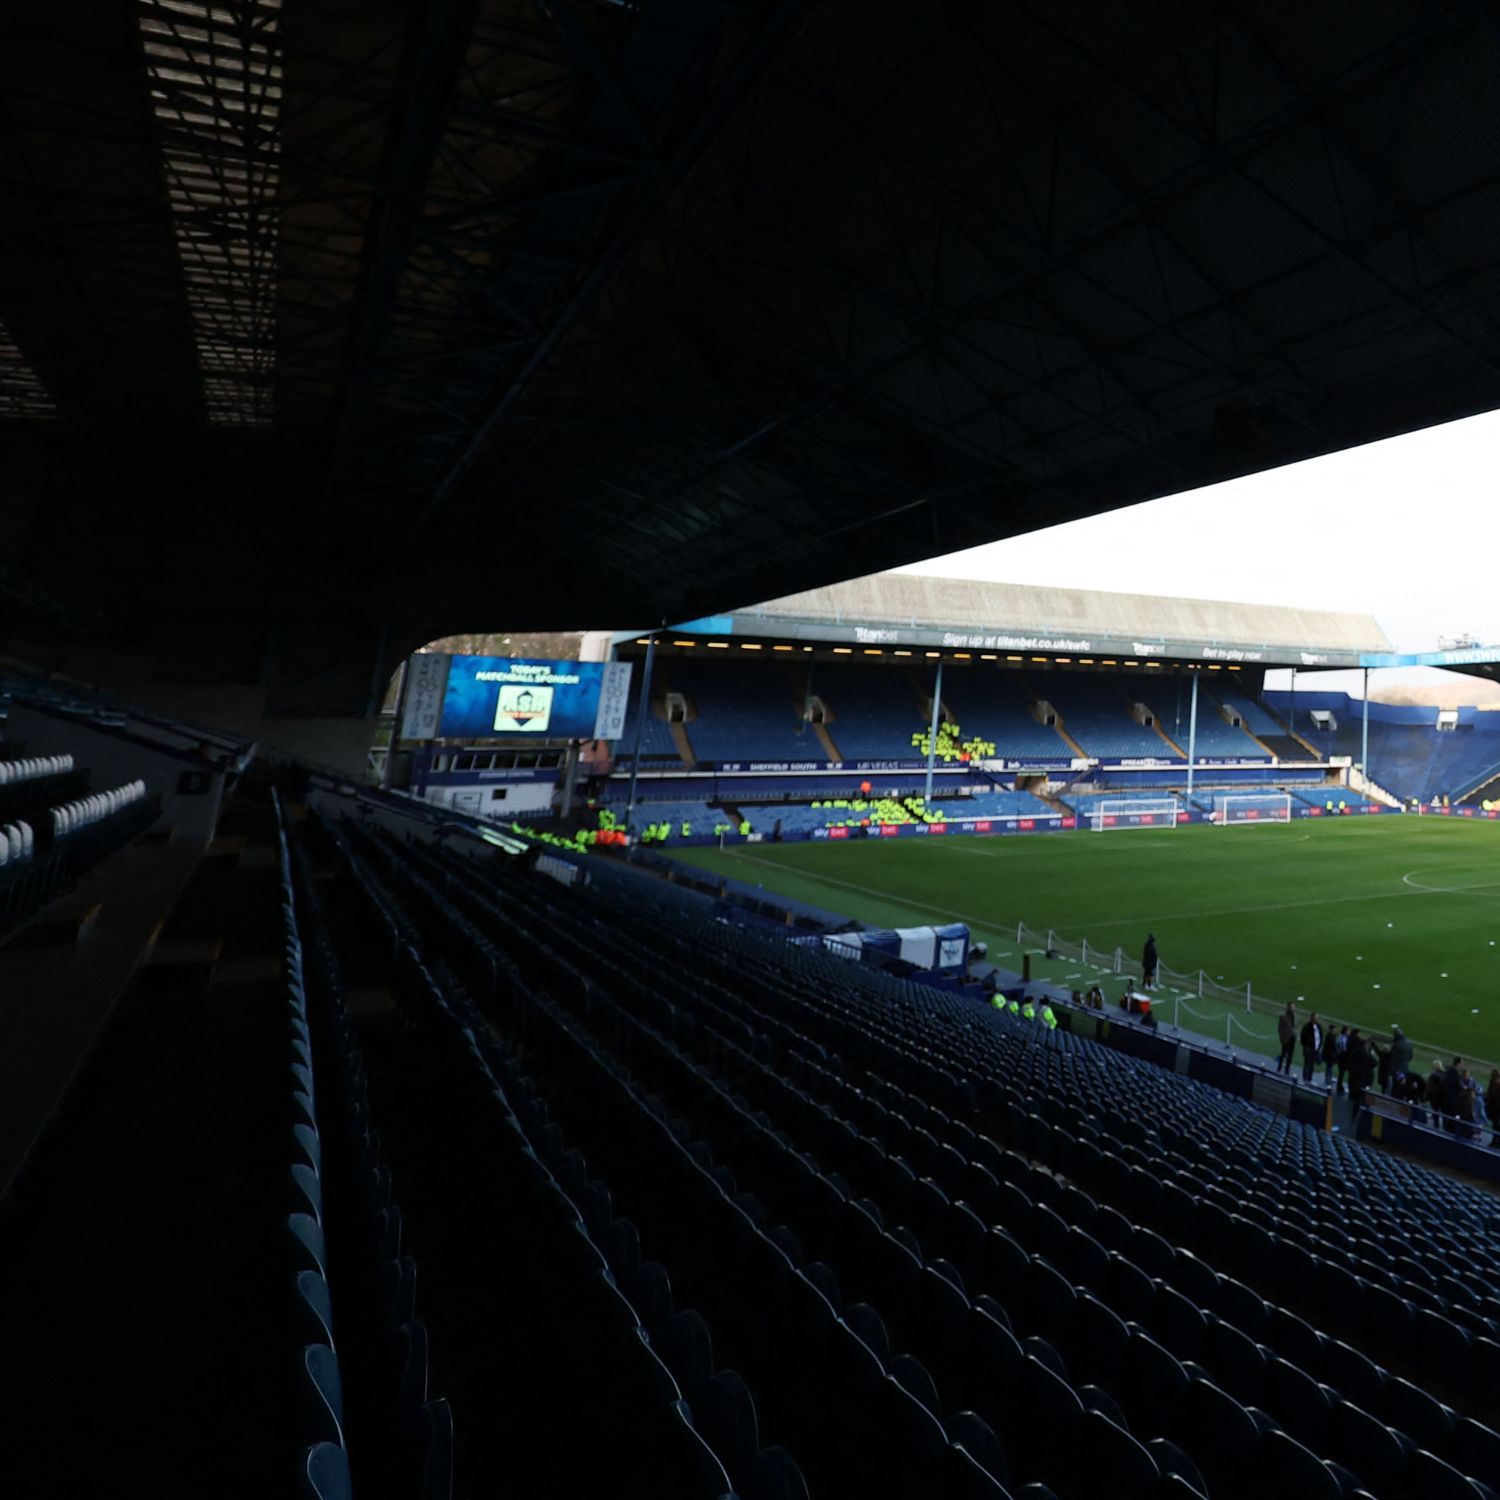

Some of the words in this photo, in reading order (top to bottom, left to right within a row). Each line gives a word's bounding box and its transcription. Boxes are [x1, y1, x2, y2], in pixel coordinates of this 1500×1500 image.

[943, 633, 967, 647] Sign
[968, 636, 984, 648] up
[985, 635, 996, 647] at
[997, 636, 1091, 651] titanbet.co.uk/swfc
[750, 763, 788, 771] SHEFFIELD
[790, 762, 817, 770] SOUTH
[867, 826, 881, 836] sky
[916, 825, 929, 834] sky
[962, 823, 976, 832] sky
[814, 829, 829, 838] sky
